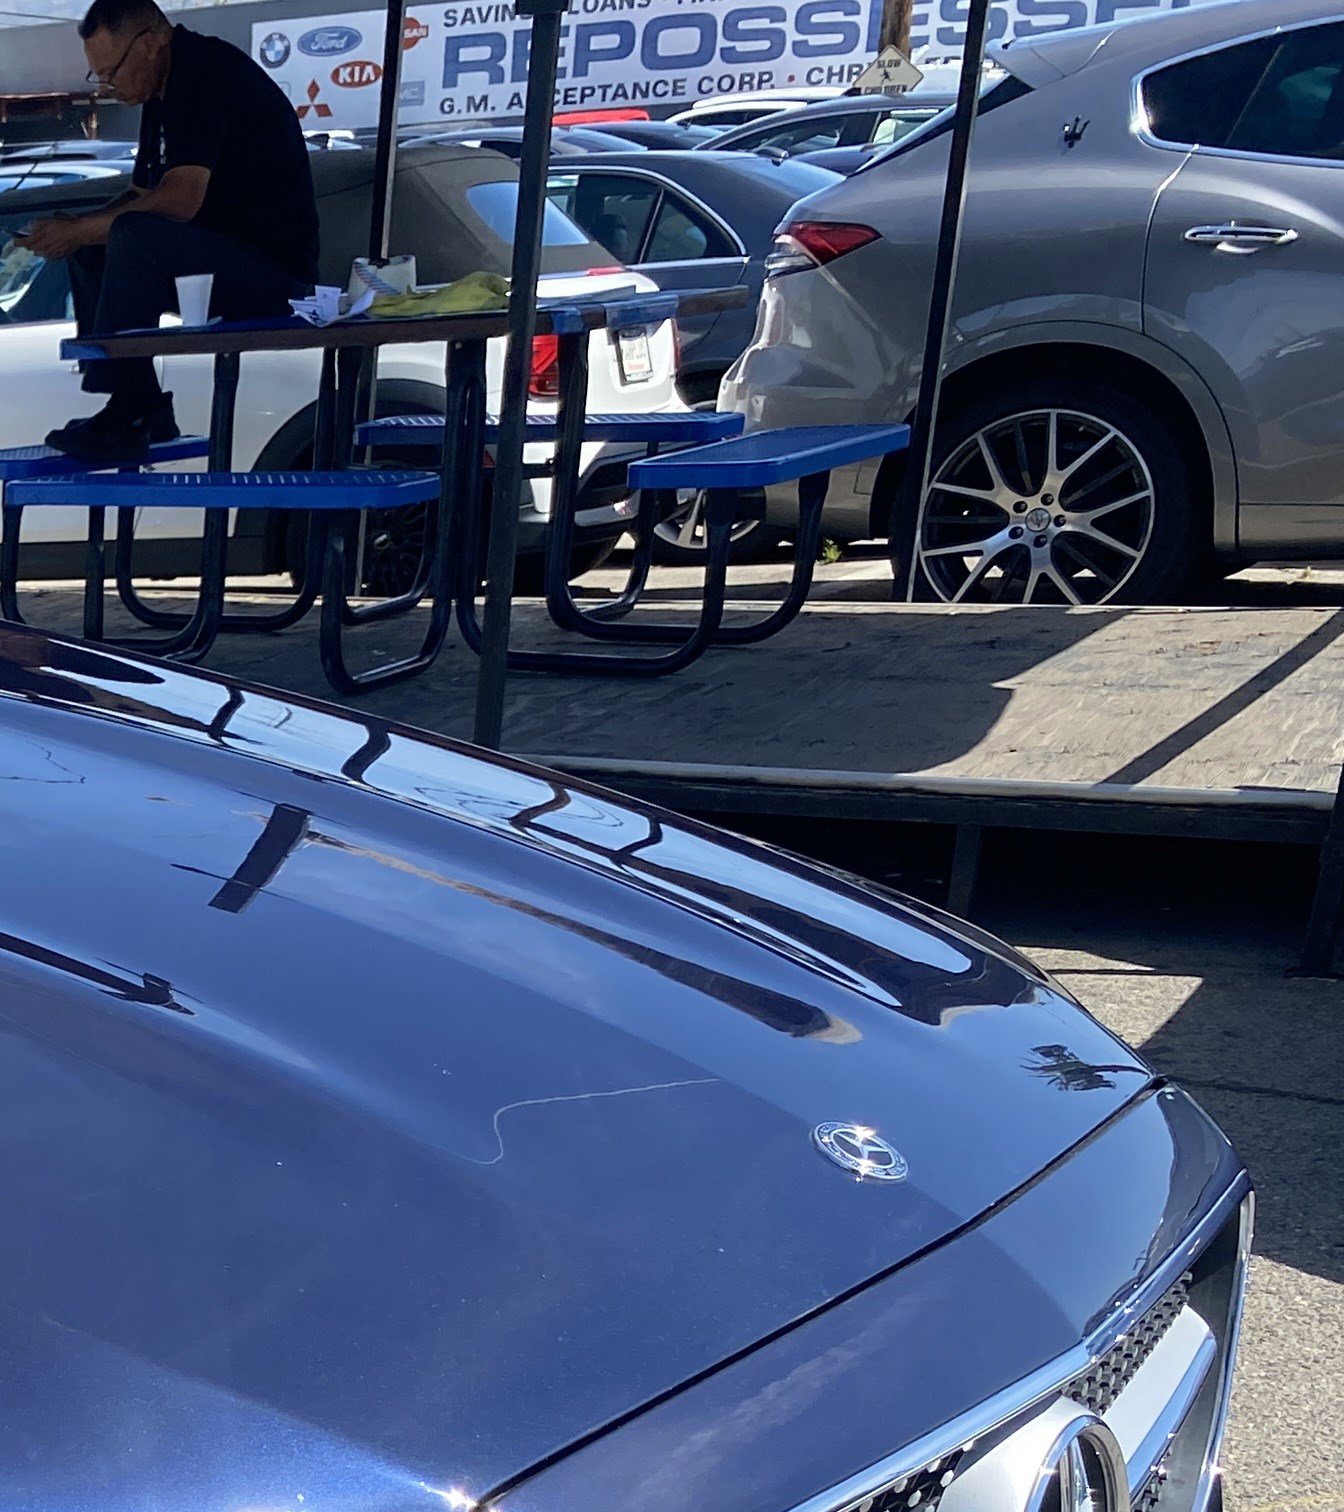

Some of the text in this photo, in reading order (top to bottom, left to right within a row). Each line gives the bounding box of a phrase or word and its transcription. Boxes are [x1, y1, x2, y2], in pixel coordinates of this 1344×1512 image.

[443, 3, 532, 28] SAVIN
[310, 32, 349, 50] Ford
[403, 26, 428, 39] SAN
[441, 0, 1198, 90] REPOSSESS
[337, 65, 376, 84] KIA
[877, 59, 902, 69] SLOW
[697, 70, 775, 95] CORP.
[439, 94, 496, 115] G.M.
[506, 76, 686, 111] ACEPTANCE
